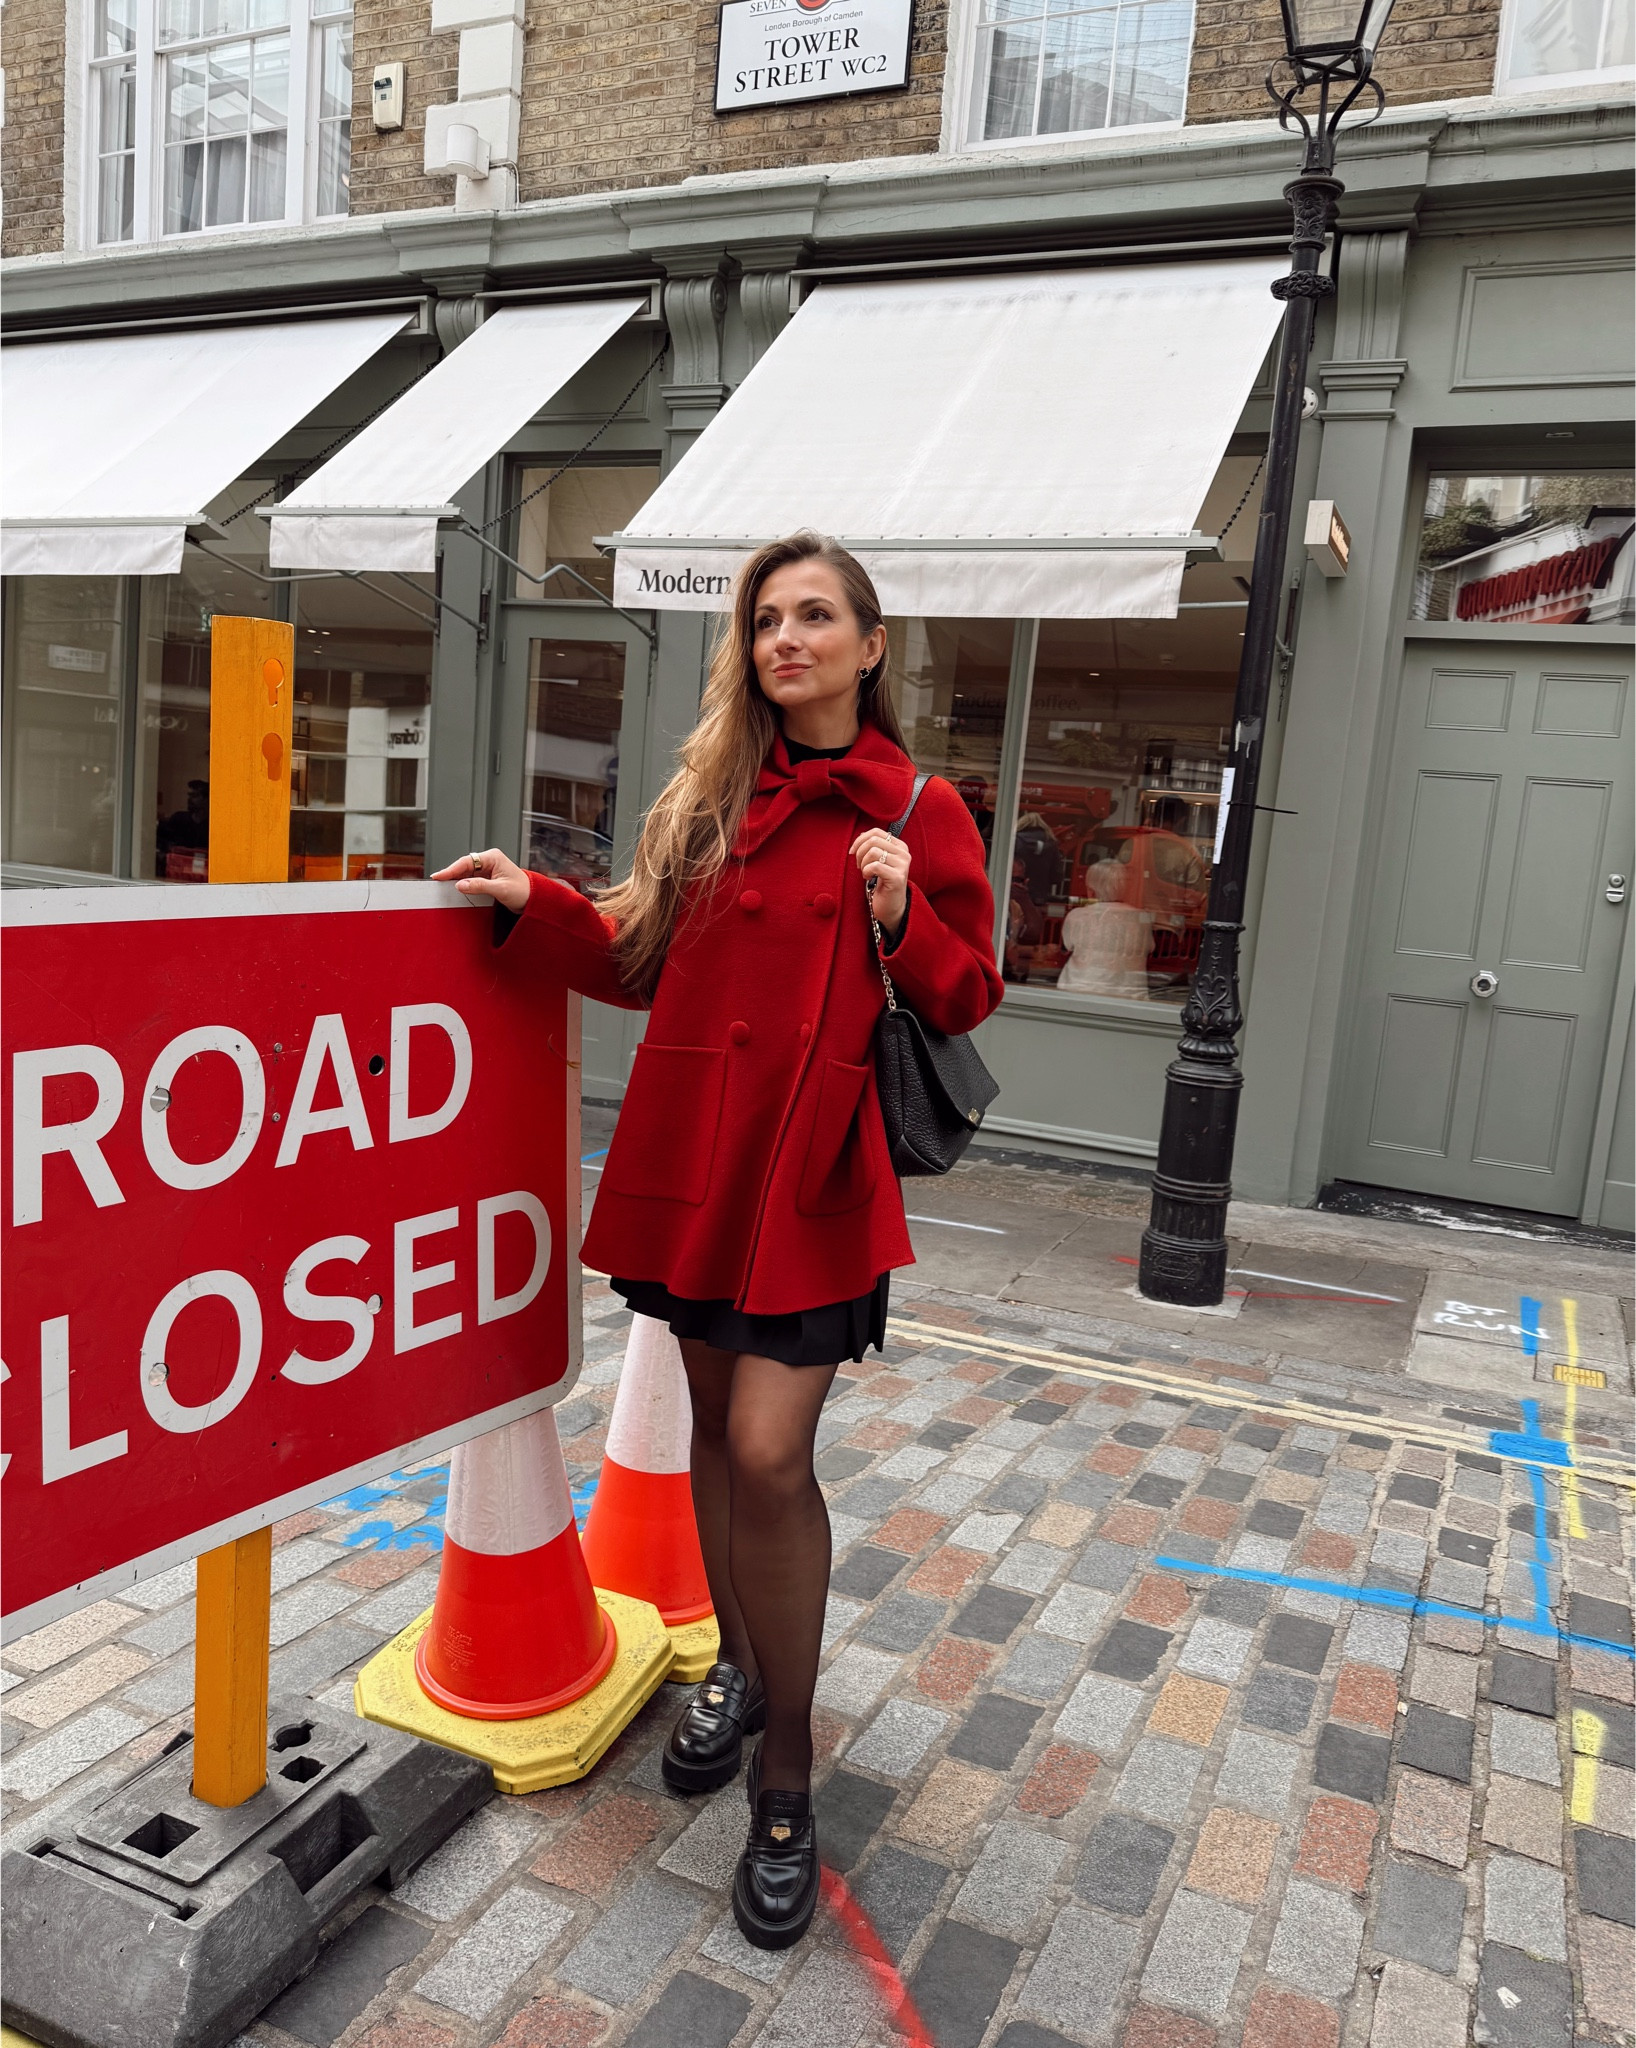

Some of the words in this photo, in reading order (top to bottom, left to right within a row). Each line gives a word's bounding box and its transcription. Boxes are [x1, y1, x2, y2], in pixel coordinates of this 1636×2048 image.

[750, 0, 787, 13] SEVEN
[764, 22, 791, 32] London
[792, 16, 823, 27] Borough
[824, 14, 831, 22] of
[833, 10, 863, 20] Camden
[765, 27, 860, 61] TOWER
[734, 58, 833, 93] STREET
[840, 54, 887, 77] WC2
[637, 567, 731, 594] Modern
[12, 1001, 473, 1227] ROAD
[1, 1190, 552, 1487] LOSED
[1433, 1311, 1551, 1340] RUN
